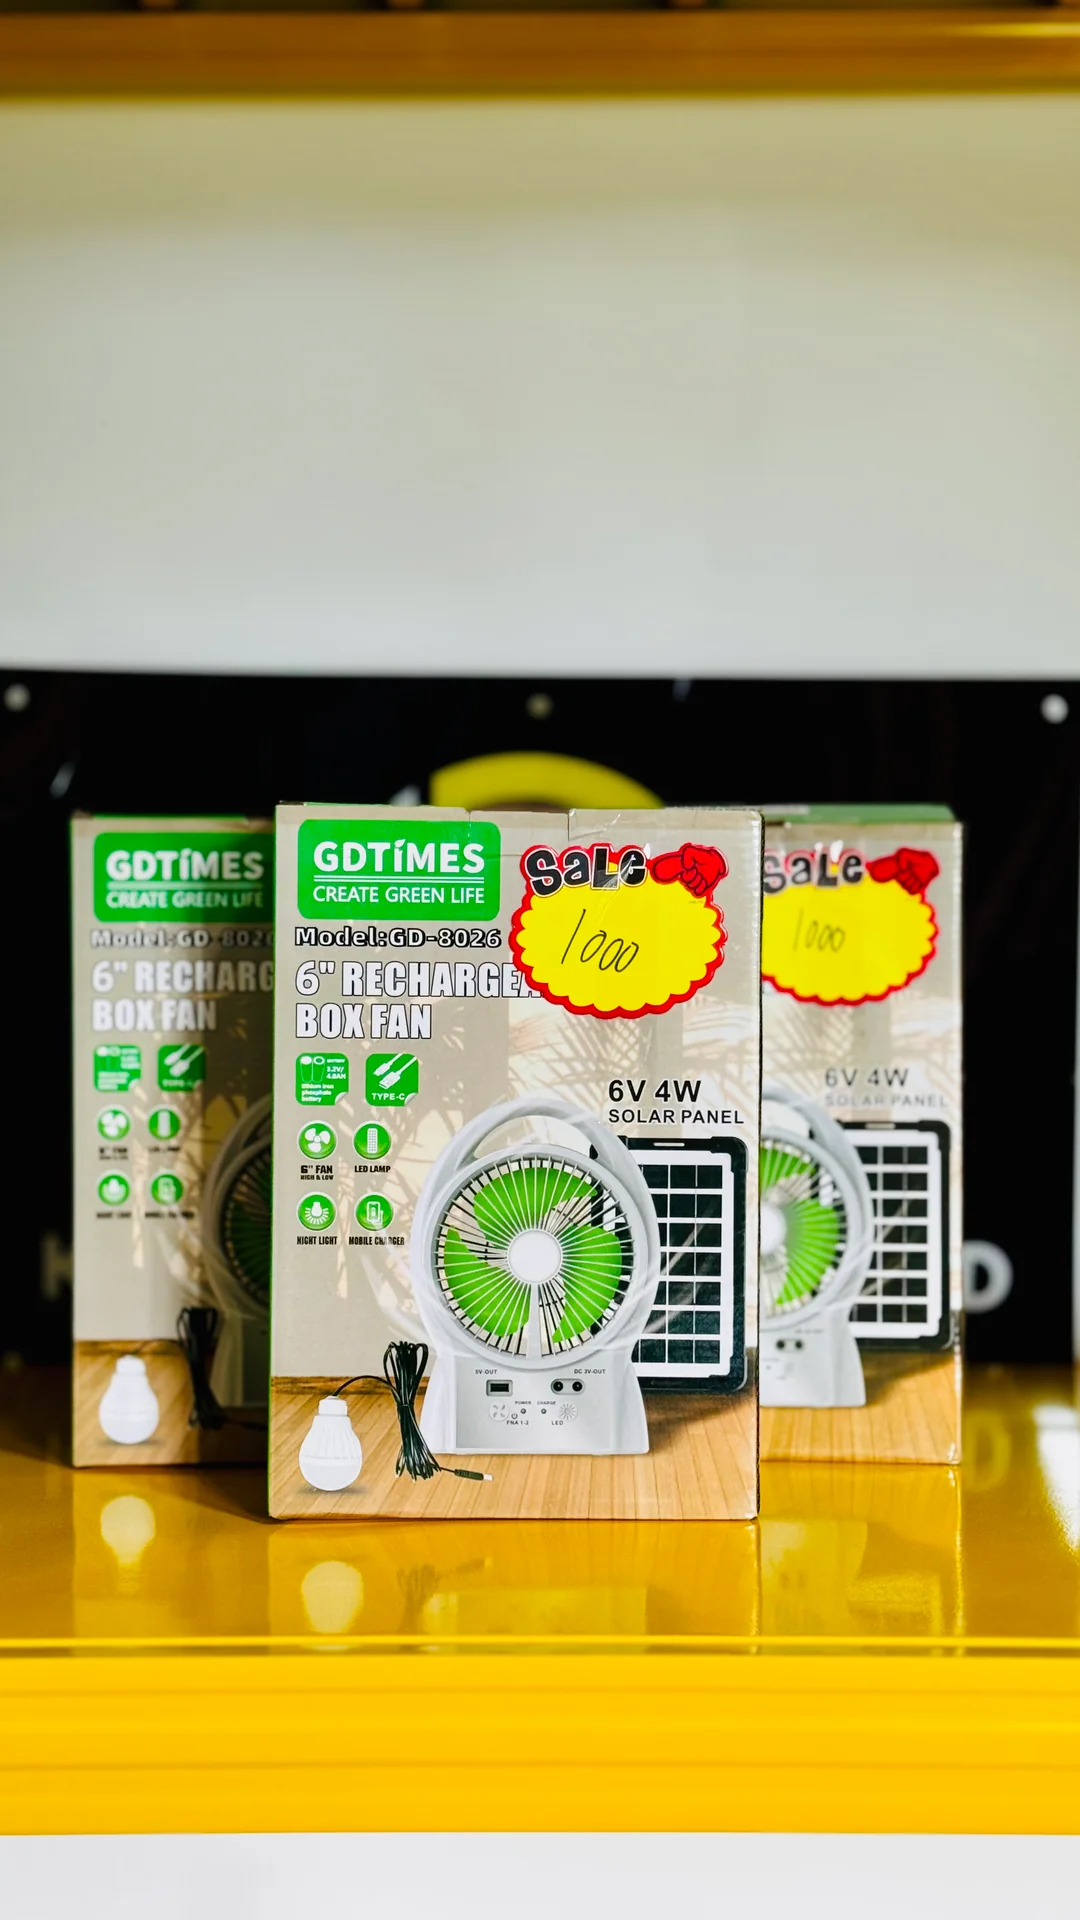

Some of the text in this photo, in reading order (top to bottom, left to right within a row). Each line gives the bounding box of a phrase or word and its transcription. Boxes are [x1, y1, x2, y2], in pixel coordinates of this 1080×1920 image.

[106, 891, 264, 908] CREATE GREEN LIFE
[313, 886, 485, 904] CREATE GREEN LIFE
[295, 926, 502, 948] Model:GD-8026
[793, 908, 846, 953] 1000
[561, 908, 640, 973] 1000
[295, 960, 336, 996] 6"
[92, 998, 217, 1031] BOX FAN
[295, 1003, 432, 1039] BOX FAN
[825, 1068, 910, 1088] 6V 4W
[371, 1092, 405, 1101] TYPE-C
[608, 1079, 702, 1103] 6V 4W
[608, 1109, 744, 1125] SOLAR PANEL
[315, 1165, 333, 1174] FAN
[354, 1165, 391, 1173] LED LAMP
[296, 1236, 338, 1245] NIGHT LIGHT
[348, 1236, 373, 1246] MOBILE
